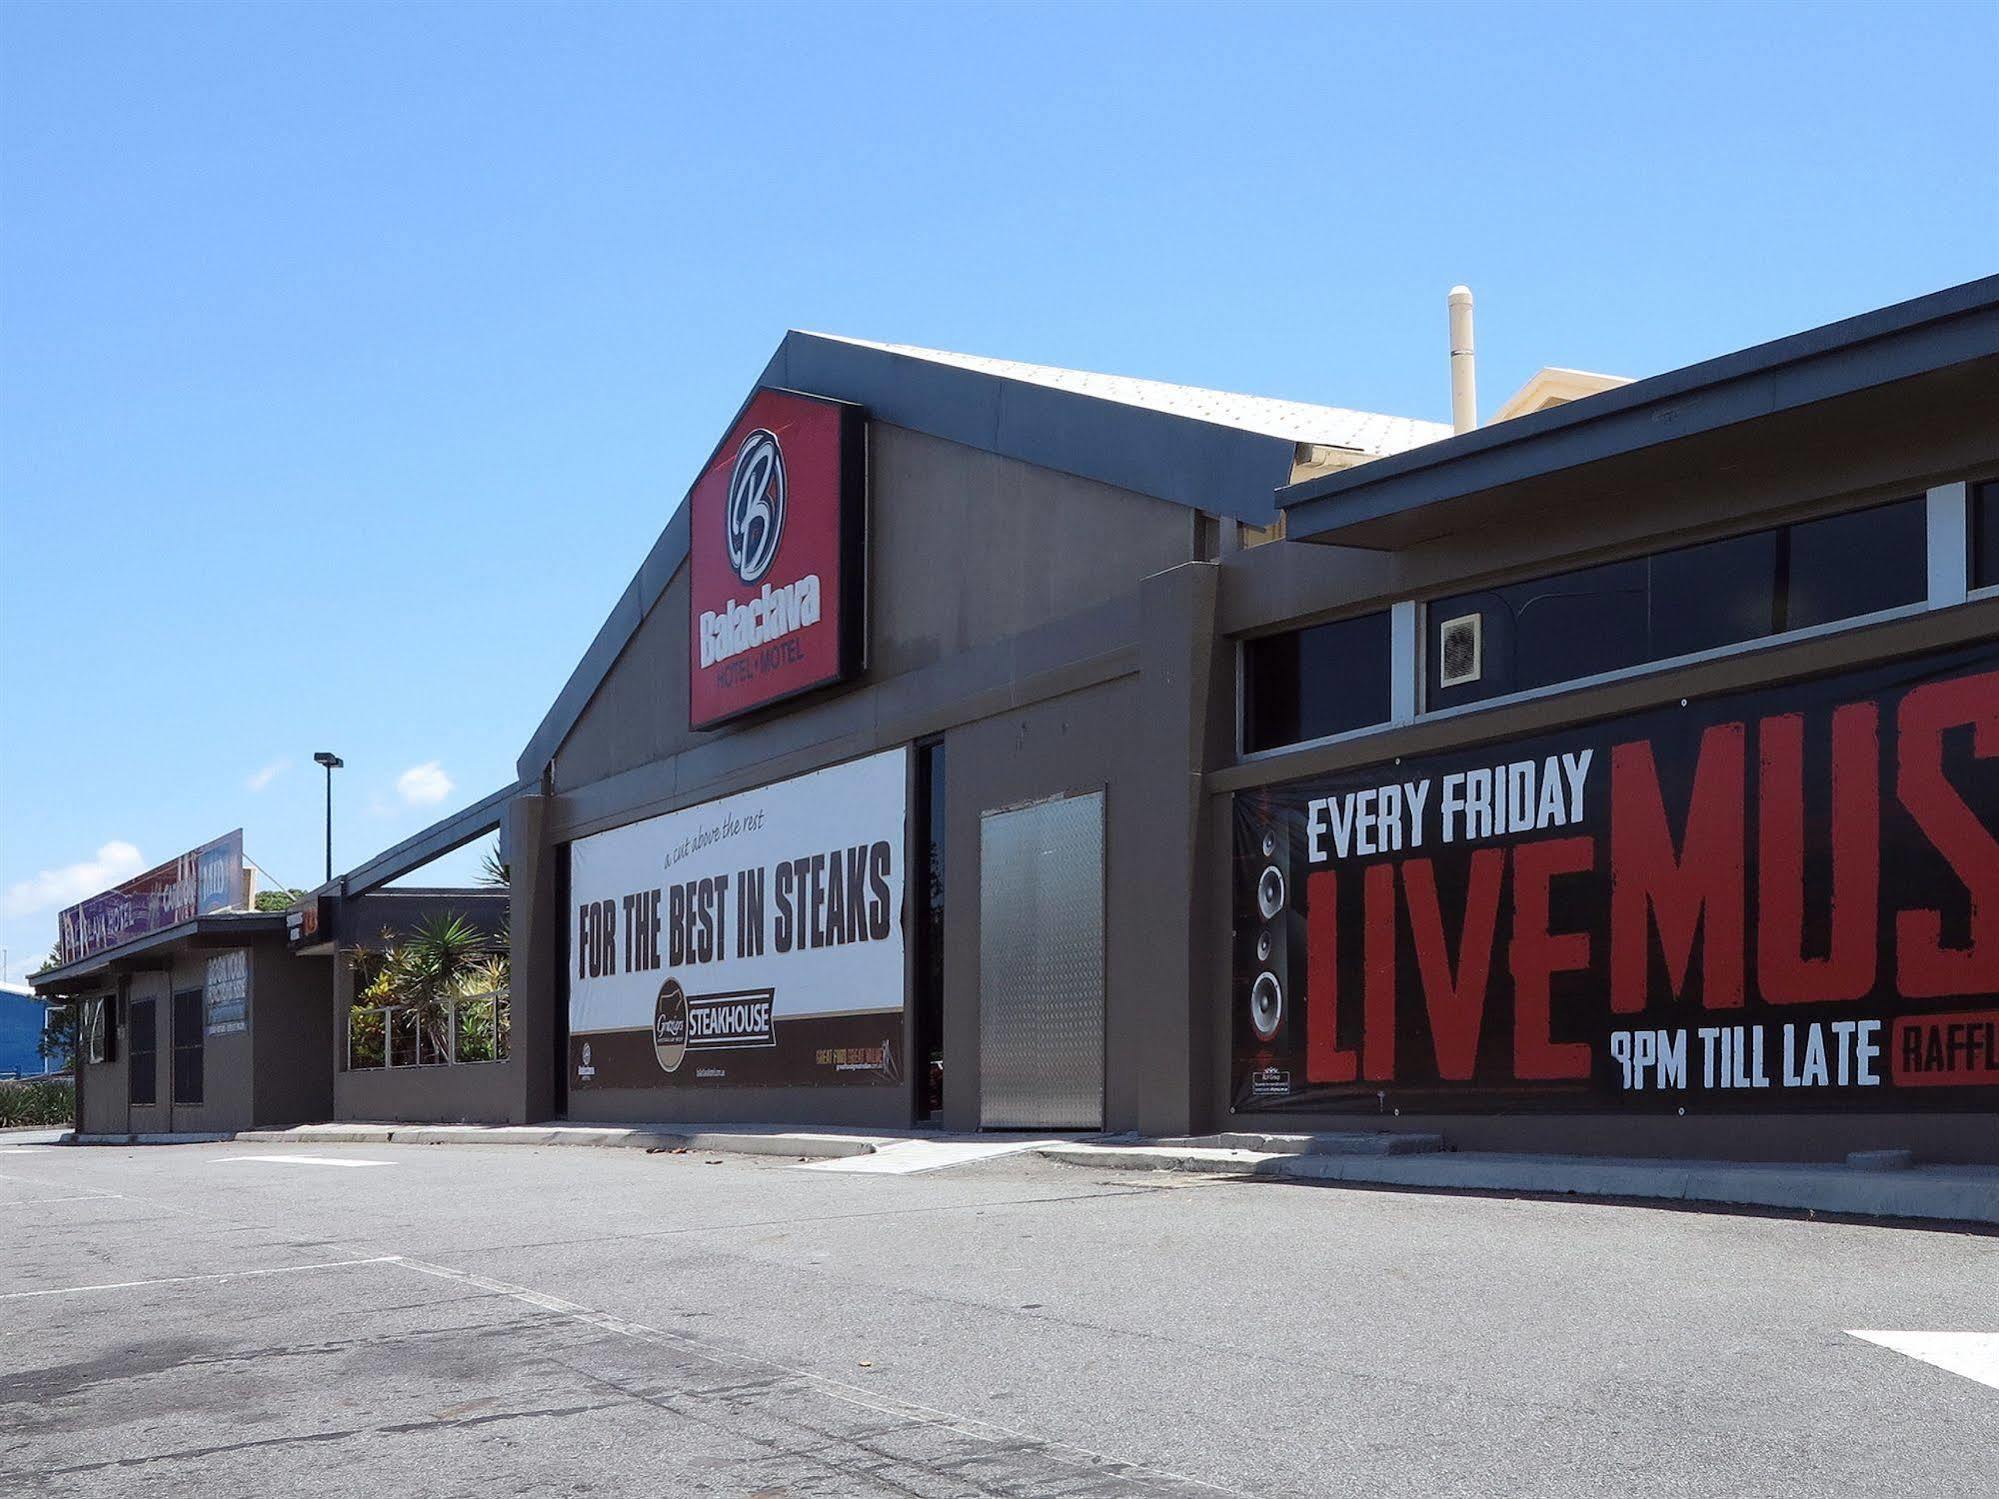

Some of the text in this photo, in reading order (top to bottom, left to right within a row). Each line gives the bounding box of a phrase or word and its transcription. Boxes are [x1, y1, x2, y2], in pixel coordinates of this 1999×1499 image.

[700, 574, 821, 669] Balaclava
[716, 638, 804, 689] HOTEL MOTEL
[673, 838, 691, 864] cut
[692, 824, 721, 852] above
[722, 812, 741, 839] the
[742, 808, 766, 832] rest
[1307, 748, 1594, 863] EVERY FRIDAY
[579, 840, 891, 979] FOR THE BEST IN STEAKS
[1306, 672, 1999, 1084] LIVE MUS
[689, 1003, 770, 1036] STEAKHOUSE
[1611, 1020, 1881, 1090] 9PM TILL LATE
